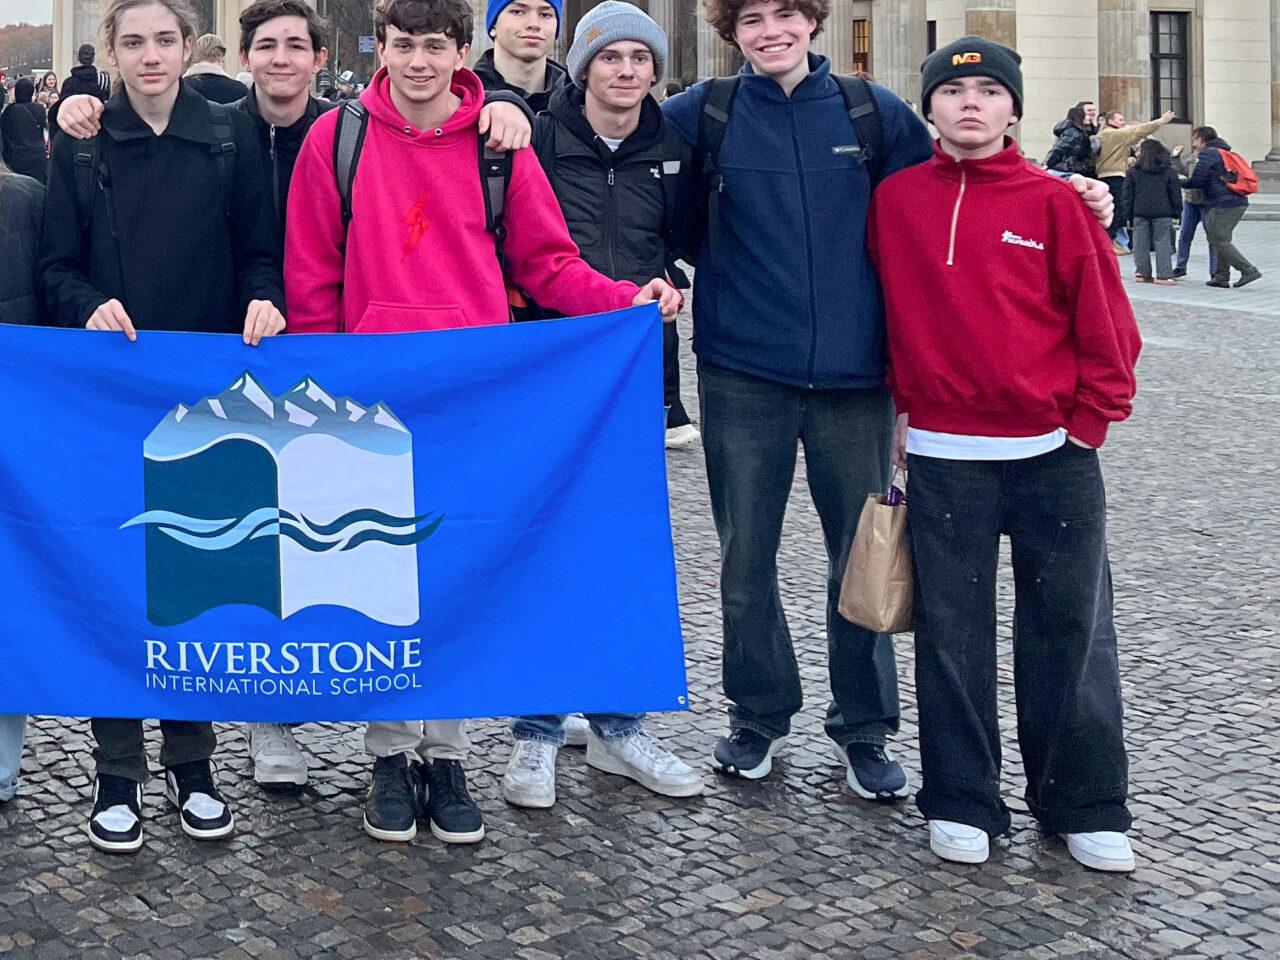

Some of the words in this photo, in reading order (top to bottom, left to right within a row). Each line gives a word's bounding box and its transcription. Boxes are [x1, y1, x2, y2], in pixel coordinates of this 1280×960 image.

[144, 638, 421, 674] RIVERSTONE
[145, 673, 322, 695] INTERNATIONAL
[330, 672, 422, 695] SCHOOL
